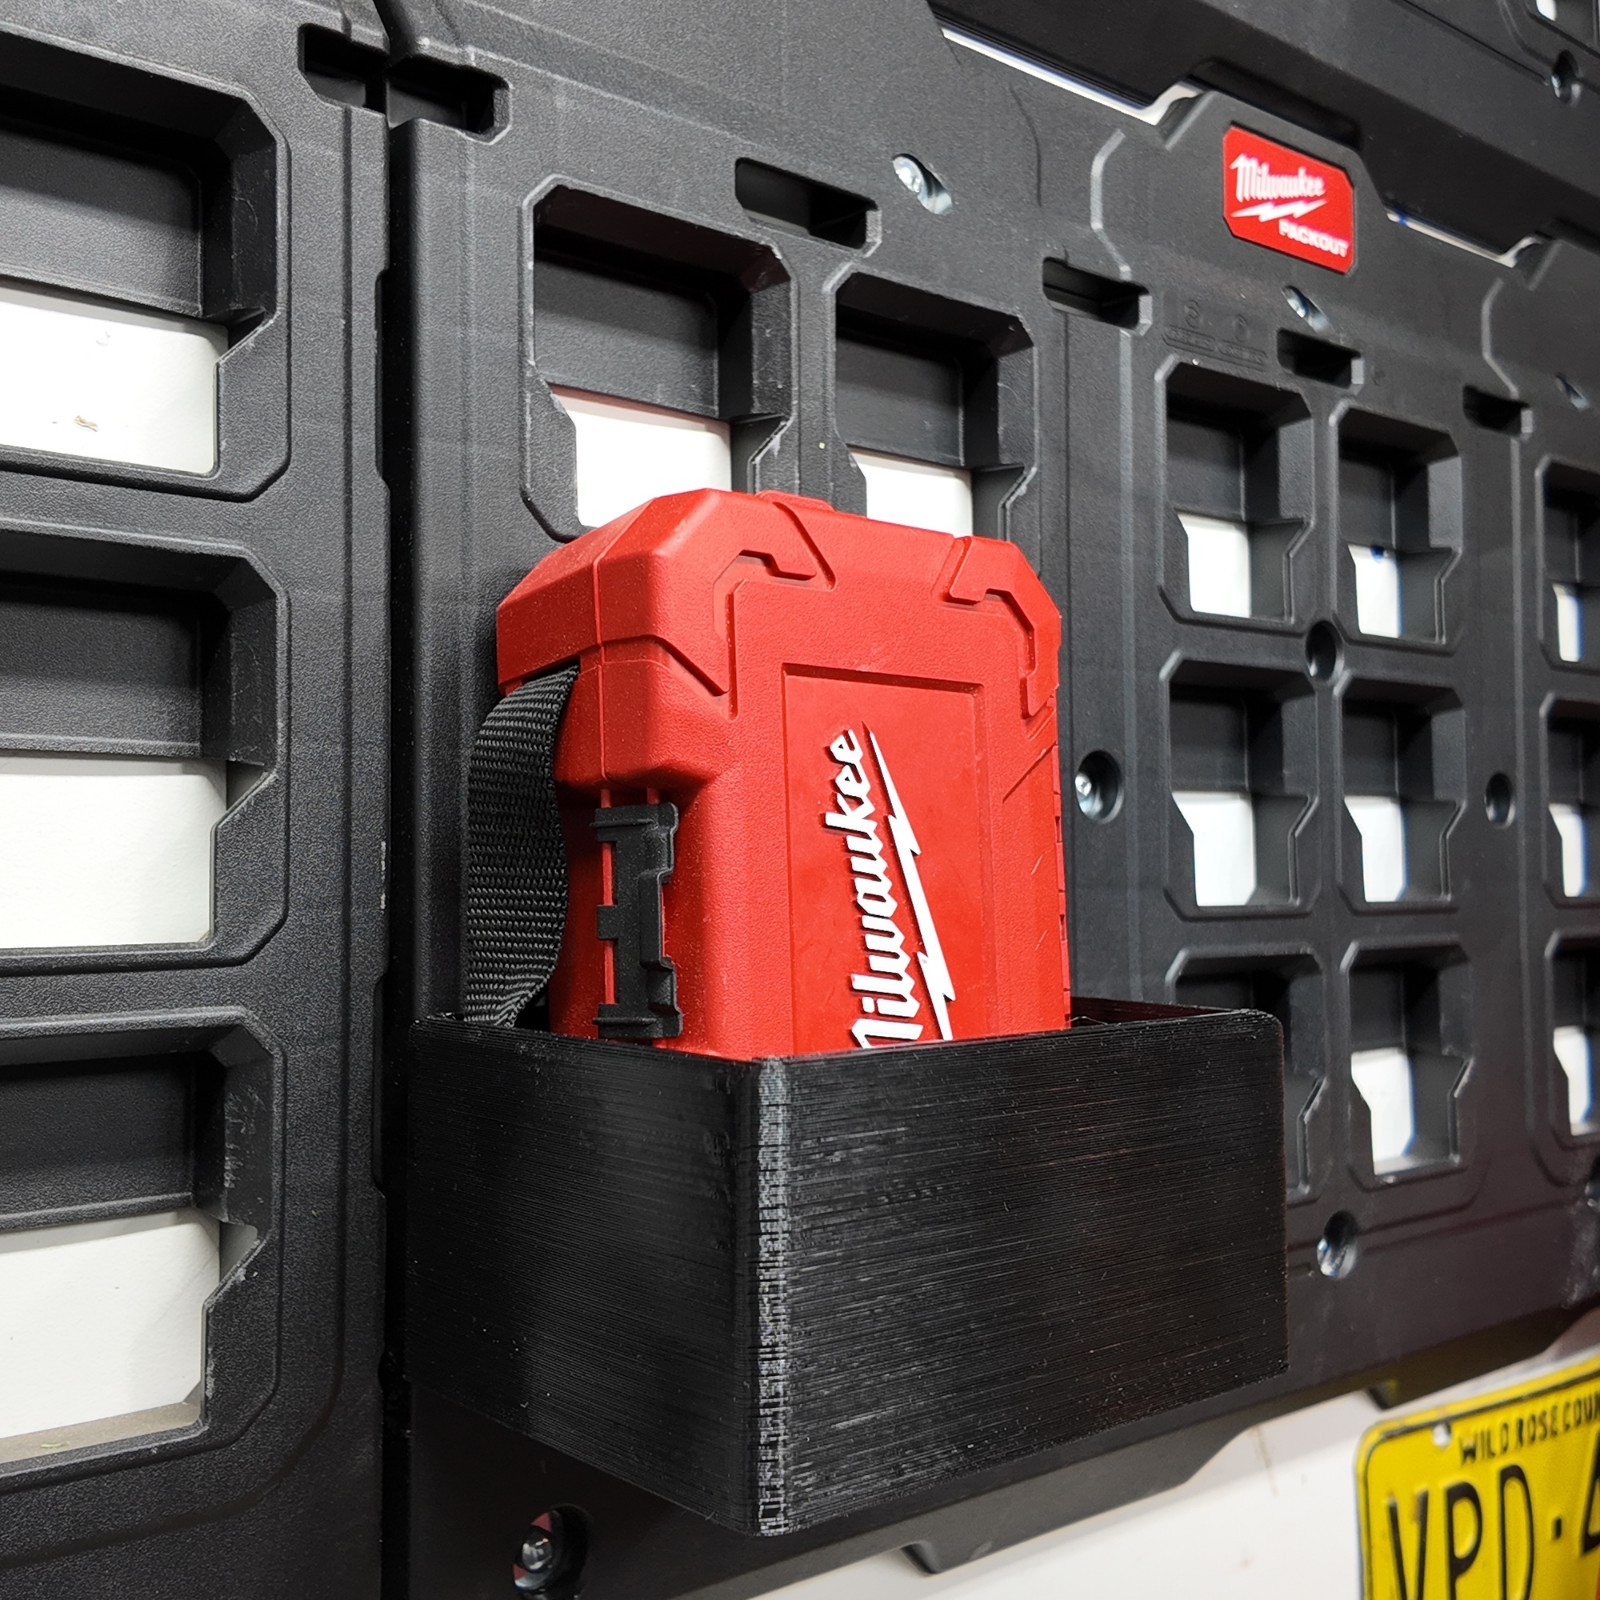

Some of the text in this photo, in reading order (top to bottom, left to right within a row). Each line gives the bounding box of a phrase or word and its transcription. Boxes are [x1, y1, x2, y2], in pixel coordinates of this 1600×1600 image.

[1230, 152, 1326, 203] Milwaukee
[1278, 218, 1349, 258] PACKOUT
[1459, 1423, 1509, 1466] WILD
